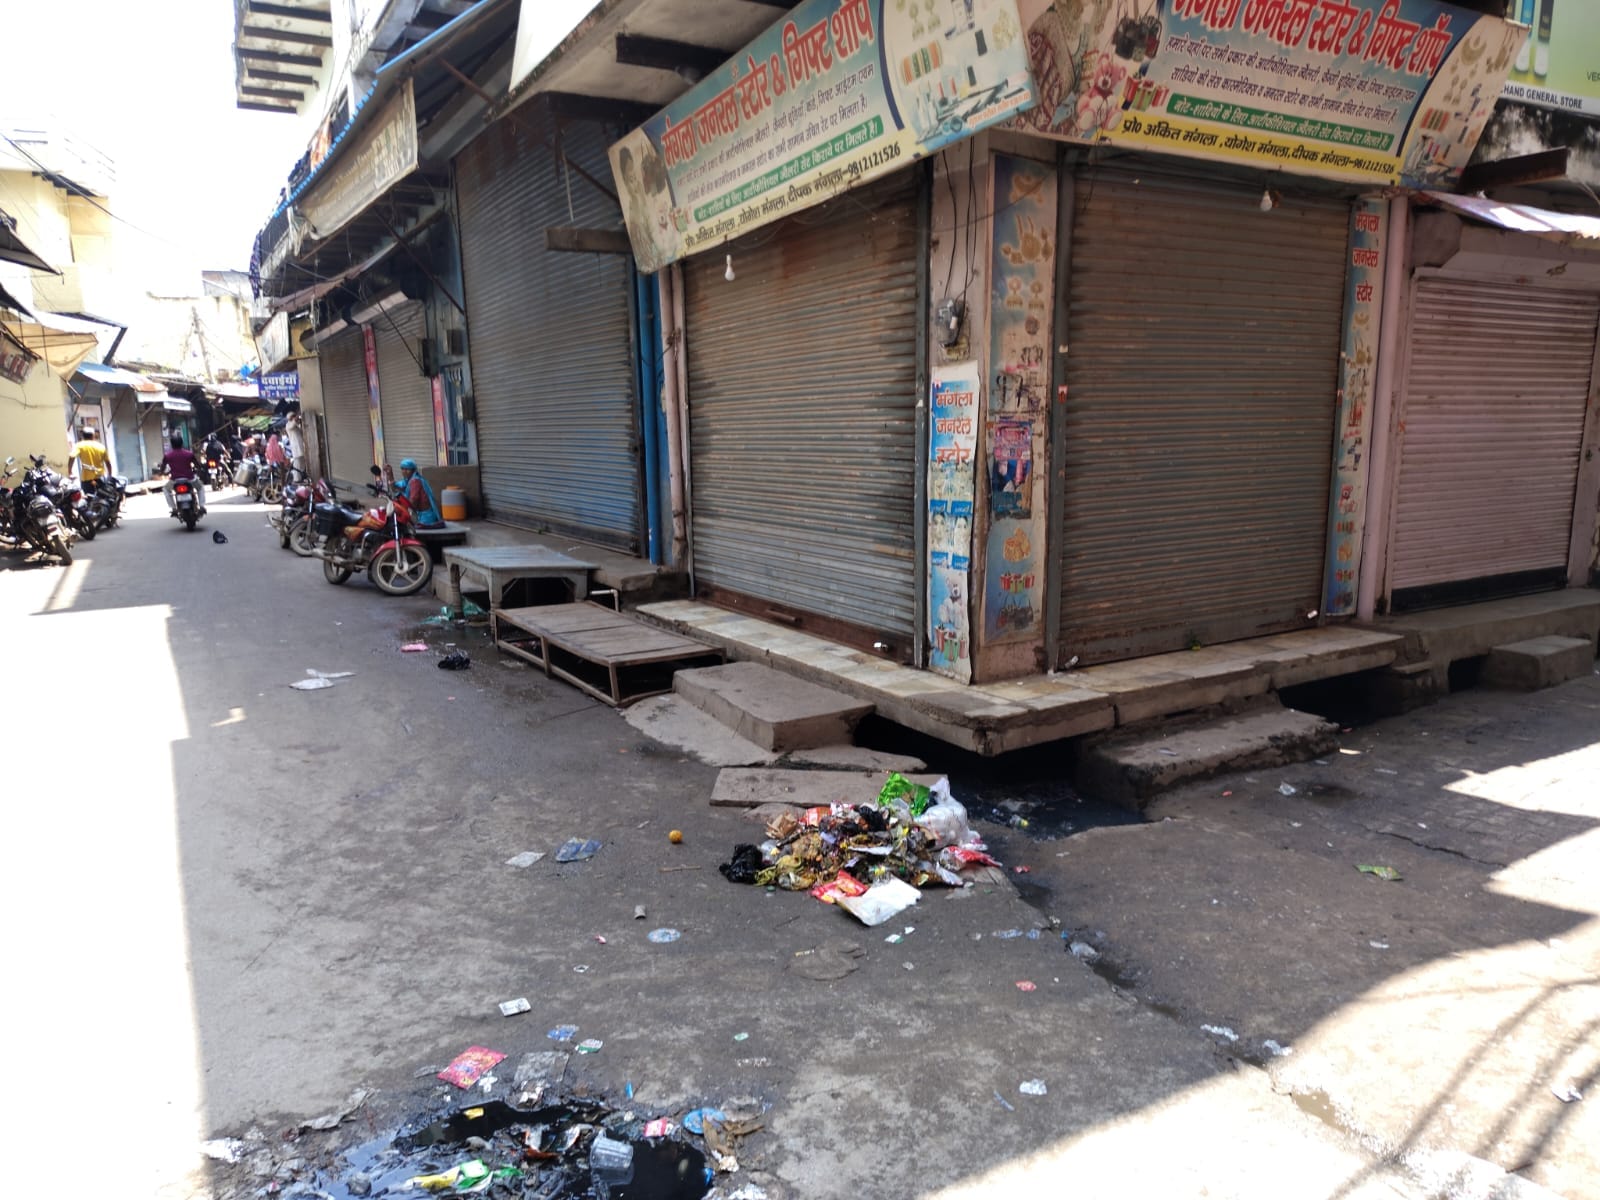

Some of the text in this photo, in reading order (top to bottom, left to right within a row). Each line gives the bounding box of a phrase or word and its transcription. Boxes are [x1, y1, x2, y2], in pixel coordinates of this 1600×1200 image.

[1165, 32, 1189, 52] हमारे
[1201, 45, 1213, 57] पर
[1172, 0, 1240, 29] गला
[1308, 0, 1359, 56] स्टोर
[1348, 9, 1373, 55] &
[1362, 0, 1420, 70] गिफ्ट
[1407, 13, 1453, 77] शॉप
[661, 115, 698, 167] मंगला
[693, 86, 740, 145] जनरल
[736, 54, 772, 120] स्टोर
[771, 54, 786, 97] &
[782, 20, 833, 91] गिफ्ट
[1526, 89, 1559, 105] GENERAL
[1560, 96, 1583, 110] STORE
[1182, 128, 1218, 146] मंगला
[1353, 248, 1379, 267] जनरल
[1356, 280, 1373, 302] स्टोर
[936, 388, 974, 407] मंगला
[936, 416, 972, 434] जनरल
[936, 442, 972, 465] स्टोर
